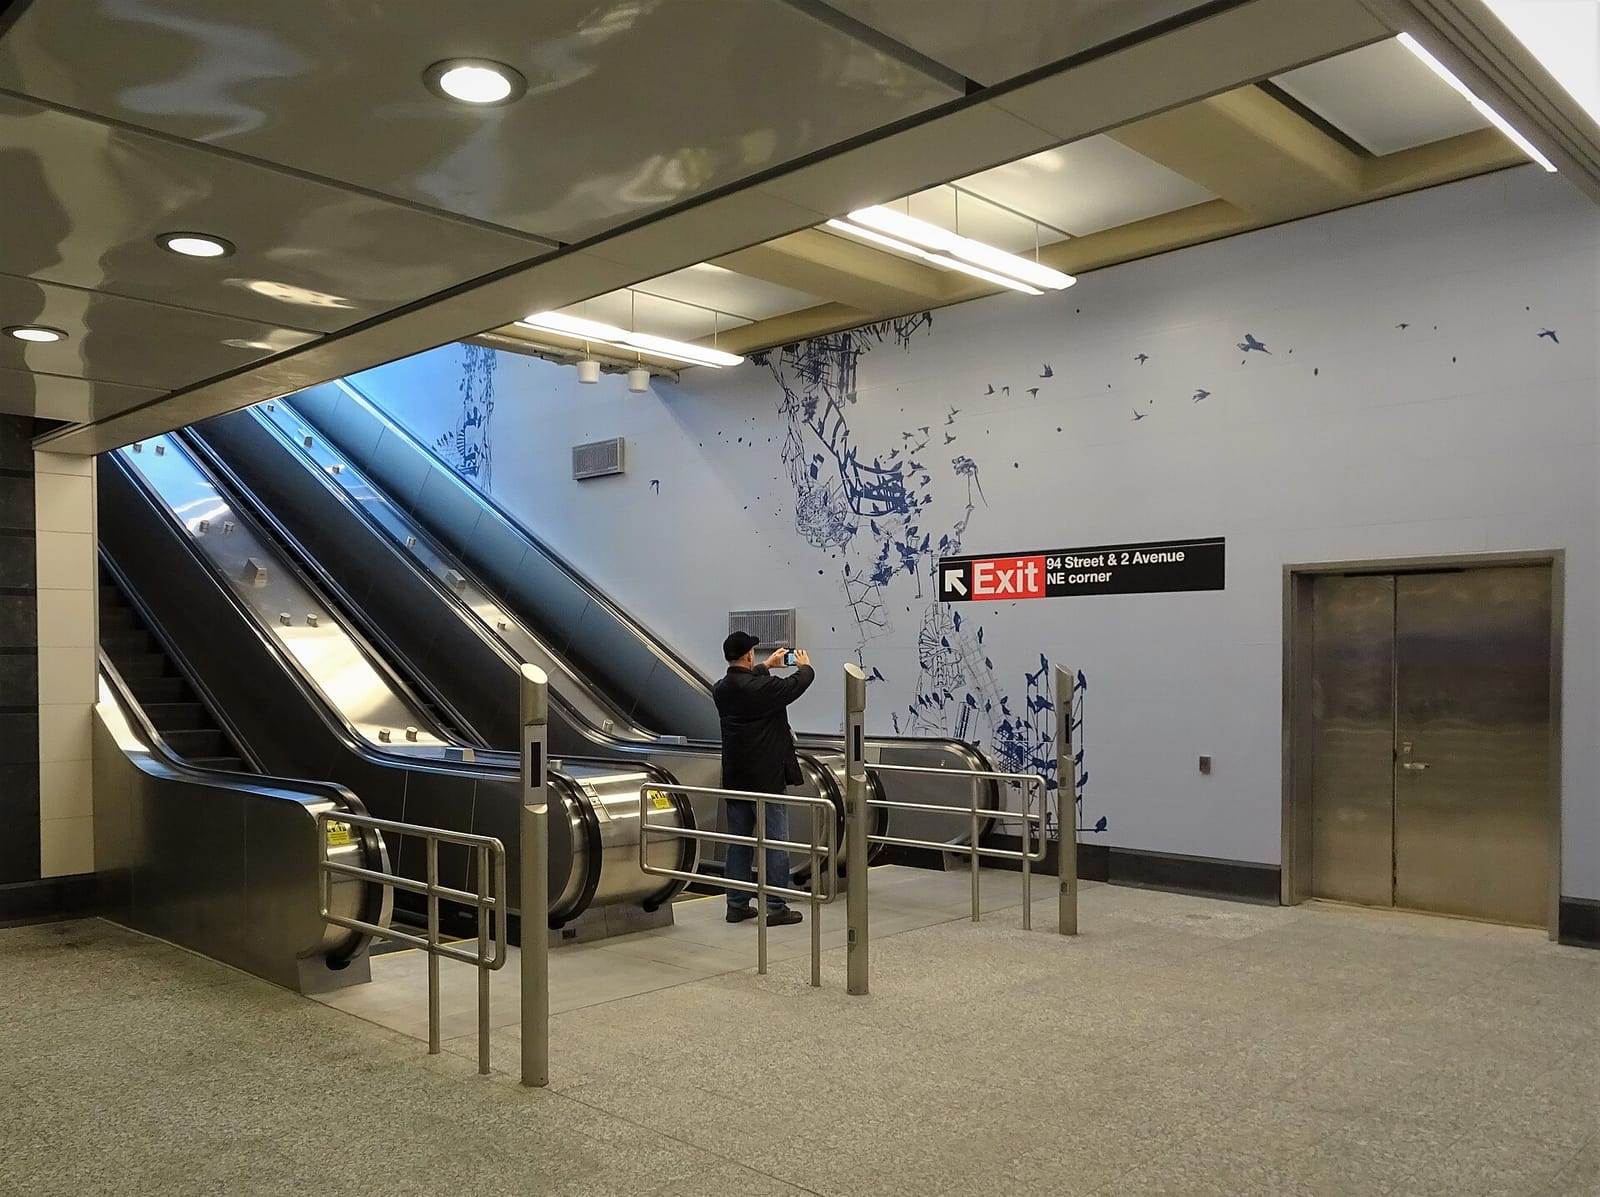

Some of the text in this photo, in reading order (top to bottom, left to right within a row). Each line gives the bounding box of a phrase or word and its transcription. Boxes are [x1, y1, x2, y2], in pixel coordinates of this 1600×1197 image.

[1047, 551, 1185, 569] 94 Street & 2 Avenue
[974, 560, 1038, 595] Exit
[1047, 572, 1112, 585] NE corner
